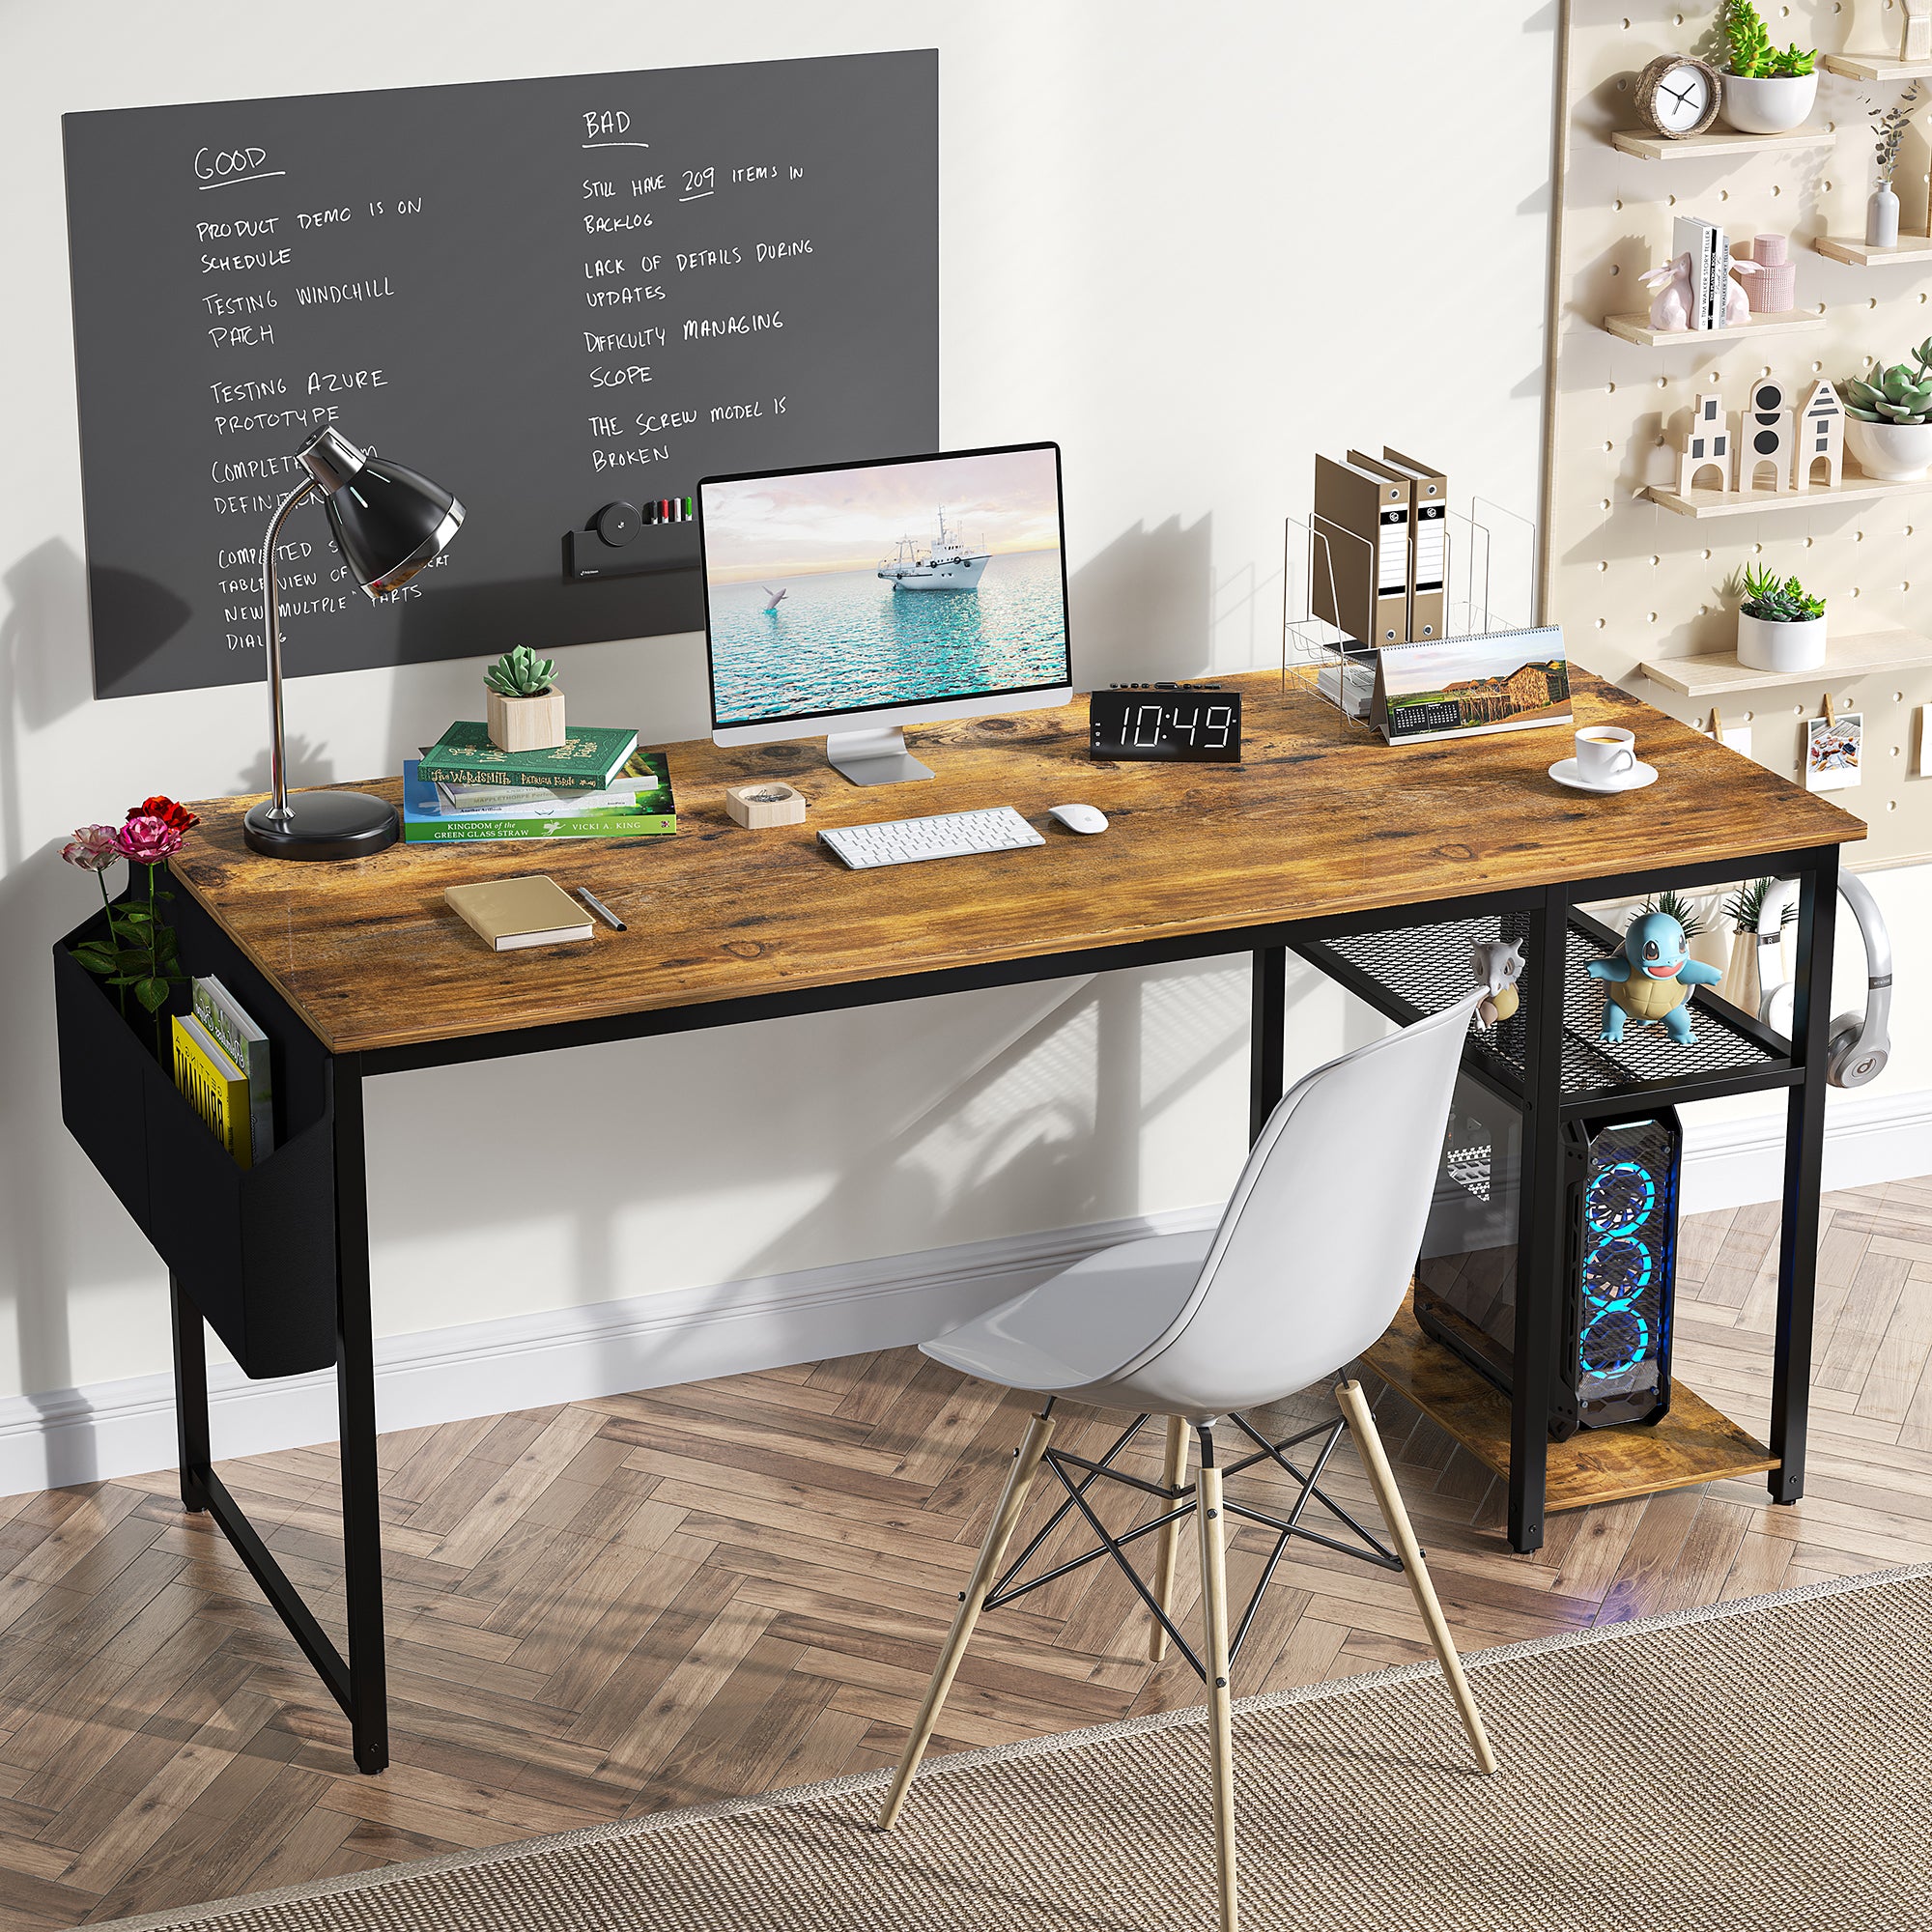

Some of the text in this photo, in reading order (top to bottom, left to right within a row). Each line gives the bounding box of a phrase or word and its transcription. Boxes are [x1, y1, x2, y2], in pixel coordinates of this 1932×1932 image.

[582, 110, 631, 139] BAD
[194, 147, 267, 180] GOOD
[582, 165, 804, 200] STILL HAVE 209 ITEMS IN
[195, 197, 422, 242] PRODUCT DEMO IS ON
[582, 213, 653, 235] BACKLOG
[200, 247, 292, 273] SCHEDULE
[584, 239, 813, 279] LACK OF DETAILS DURING
[201, 276, 395, 316] TESTING WINDCHILL
[585, 285, 667, 307] UPDATES
[208, 324, 274, 349] PATCH
[582, 310, 784, 353] DIFFICULTY MANAGING
[210, 369, 388, 404] TESTING AZURE
[589, 365, 653, 388] SCOPE
[213, 405, 340, 436] PROTOTYPE
[587, 395, 786, 438] THE SCREW MODEL IS
[592, 444, 669, 472] BROKEN
[218, 542, 312, 569] COMPLTED
[276, 572, 317, 590] VIEW
[329, 565, 348, 582] OF
[224, 606, 264, 622] NEW
[225, 632, 287, 651] DIALG
[1121, 705, 1232, 749] 10:49
[434, 831, 465, 839] GREEN
[497, 829, 529, 838] STRAW
[447, 822, 492, 831] KINGDOM
[494, 822, 503, 831] of
[572, 822, 600, 831] VICKI
[616, 821, 641, 830] KING
